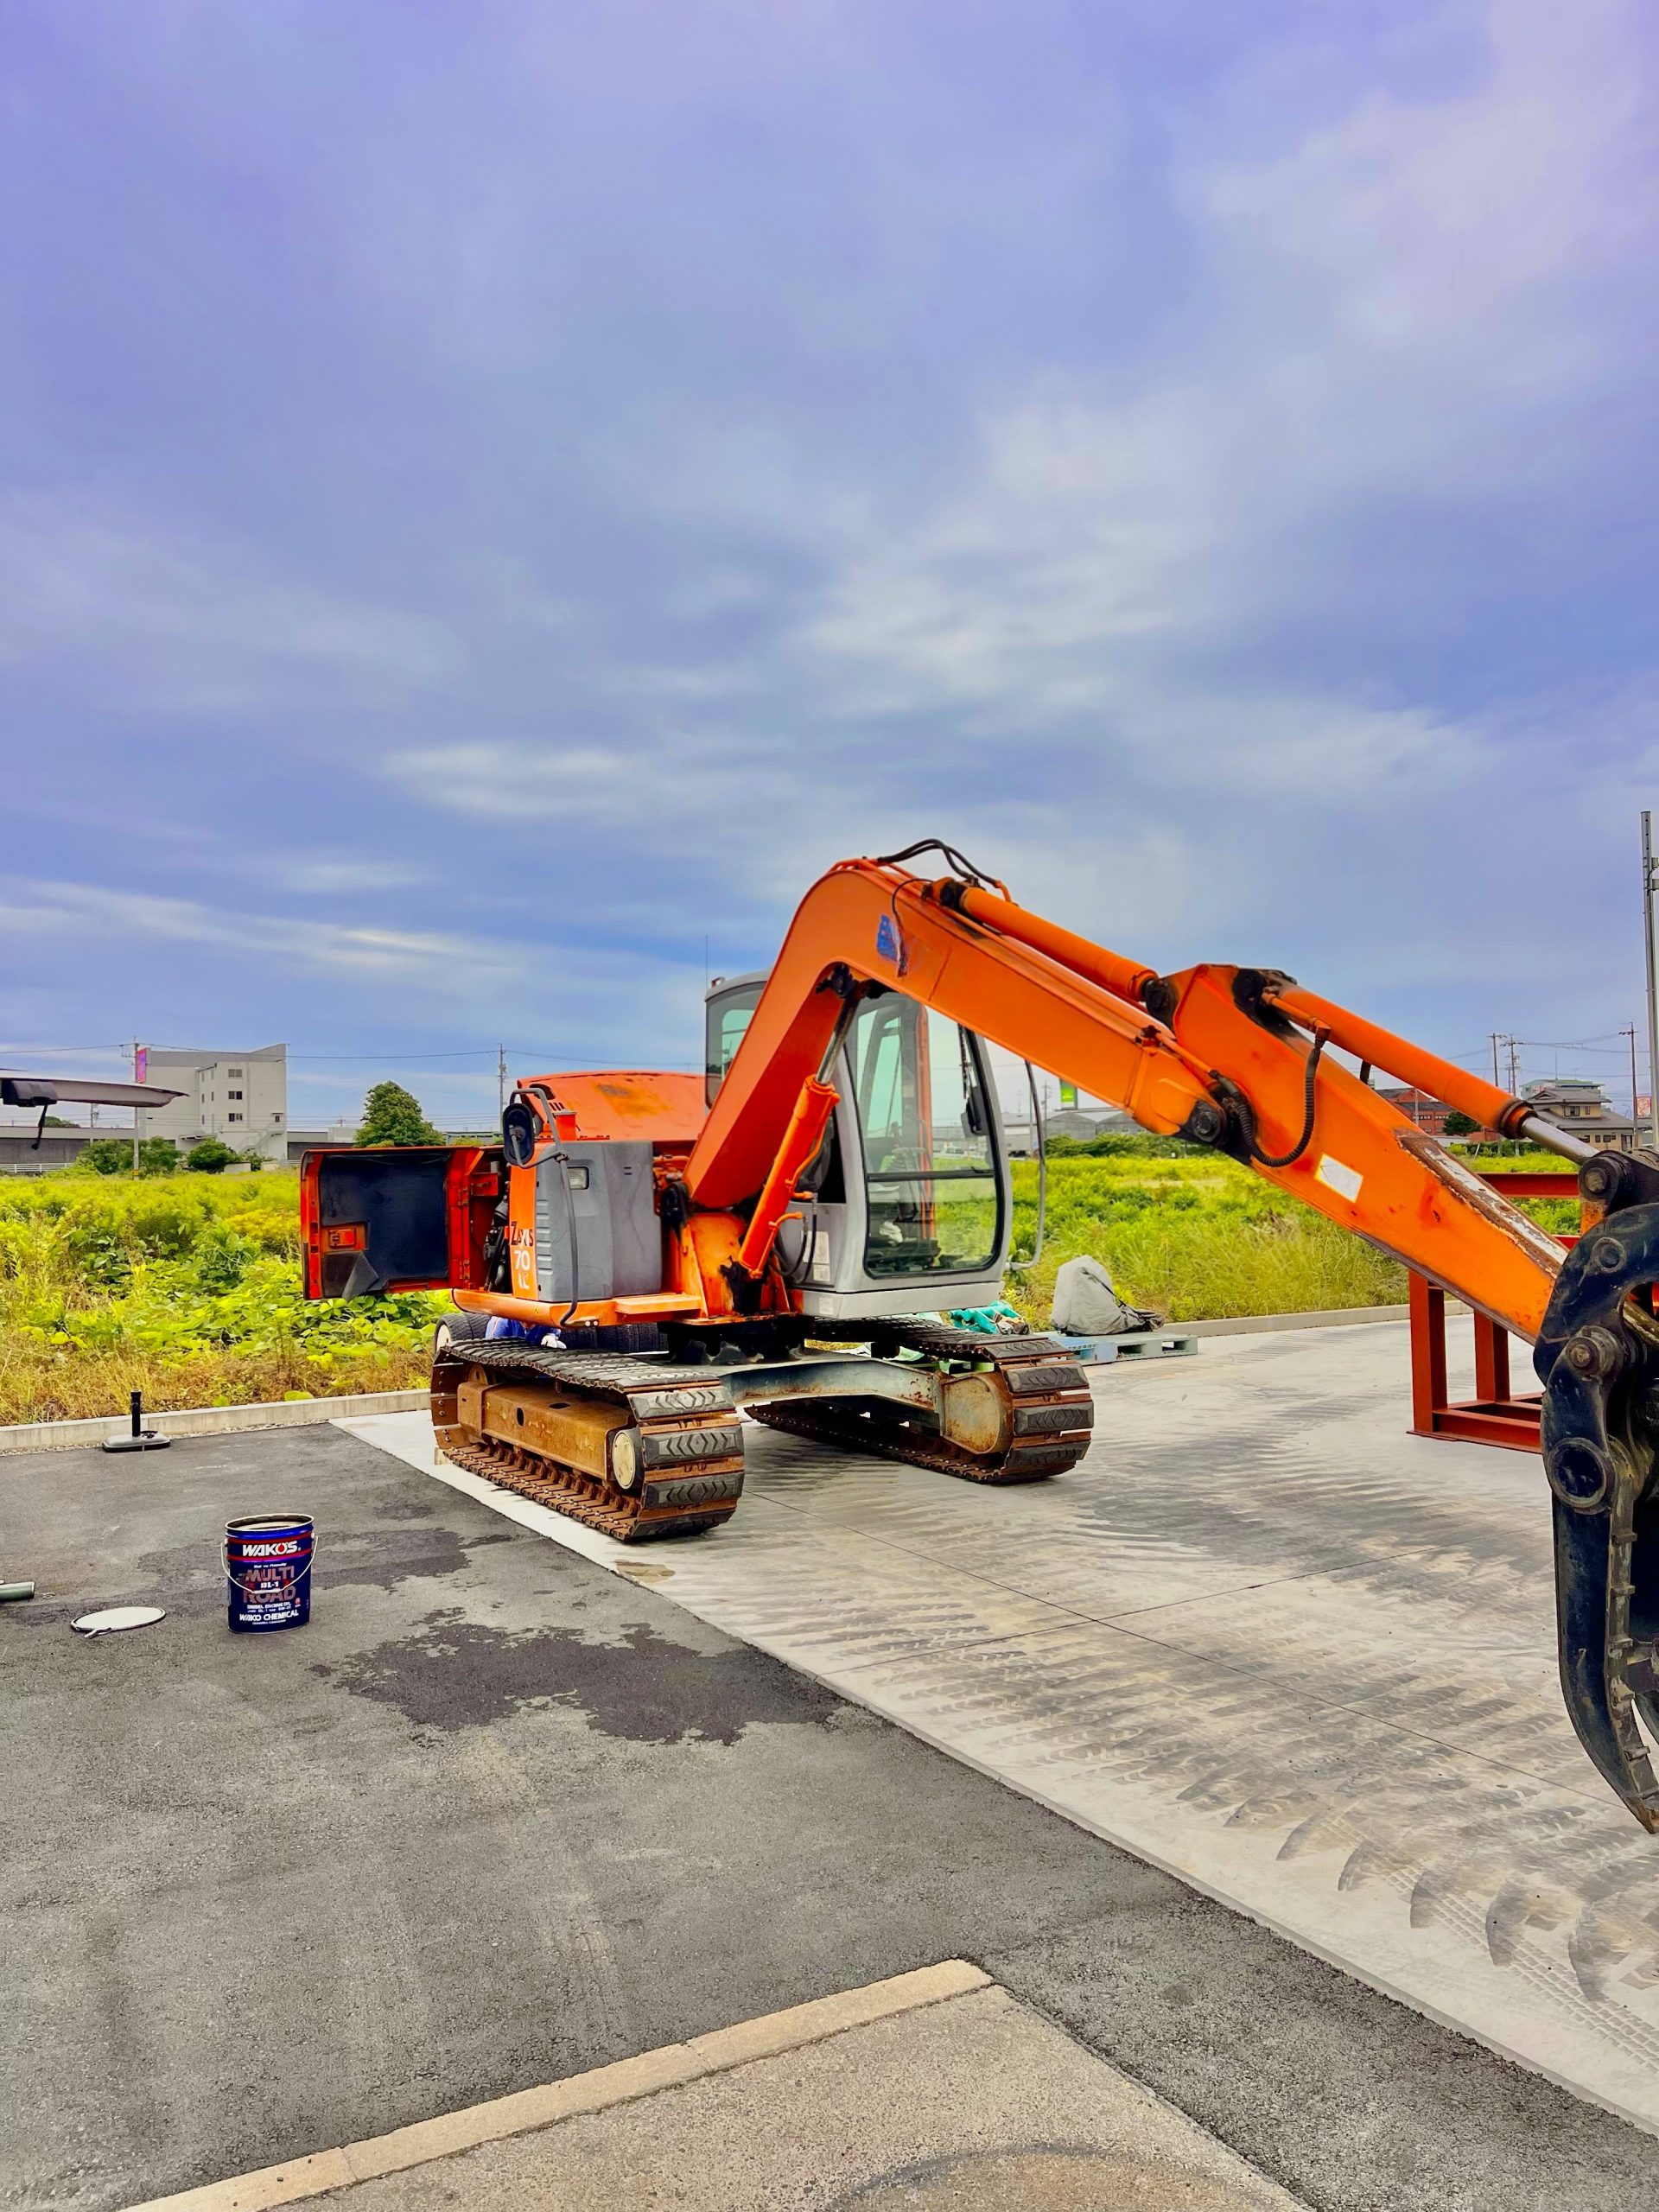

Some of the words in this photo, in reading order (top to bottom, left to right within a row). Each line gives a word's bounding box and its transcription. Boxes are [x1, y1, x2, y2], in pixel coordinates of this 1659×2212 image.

[511, 1221, 534, 1247] ZAXIS
[513, 1249, 531, 1271] 70
[245, 1566, 295, 1582] MULTI
[243, 1586, 296, 1604] ROAD
[239, 1613, 262, 1622] WAKO
[263, 1610, 299, 1621] CHEMICAL
